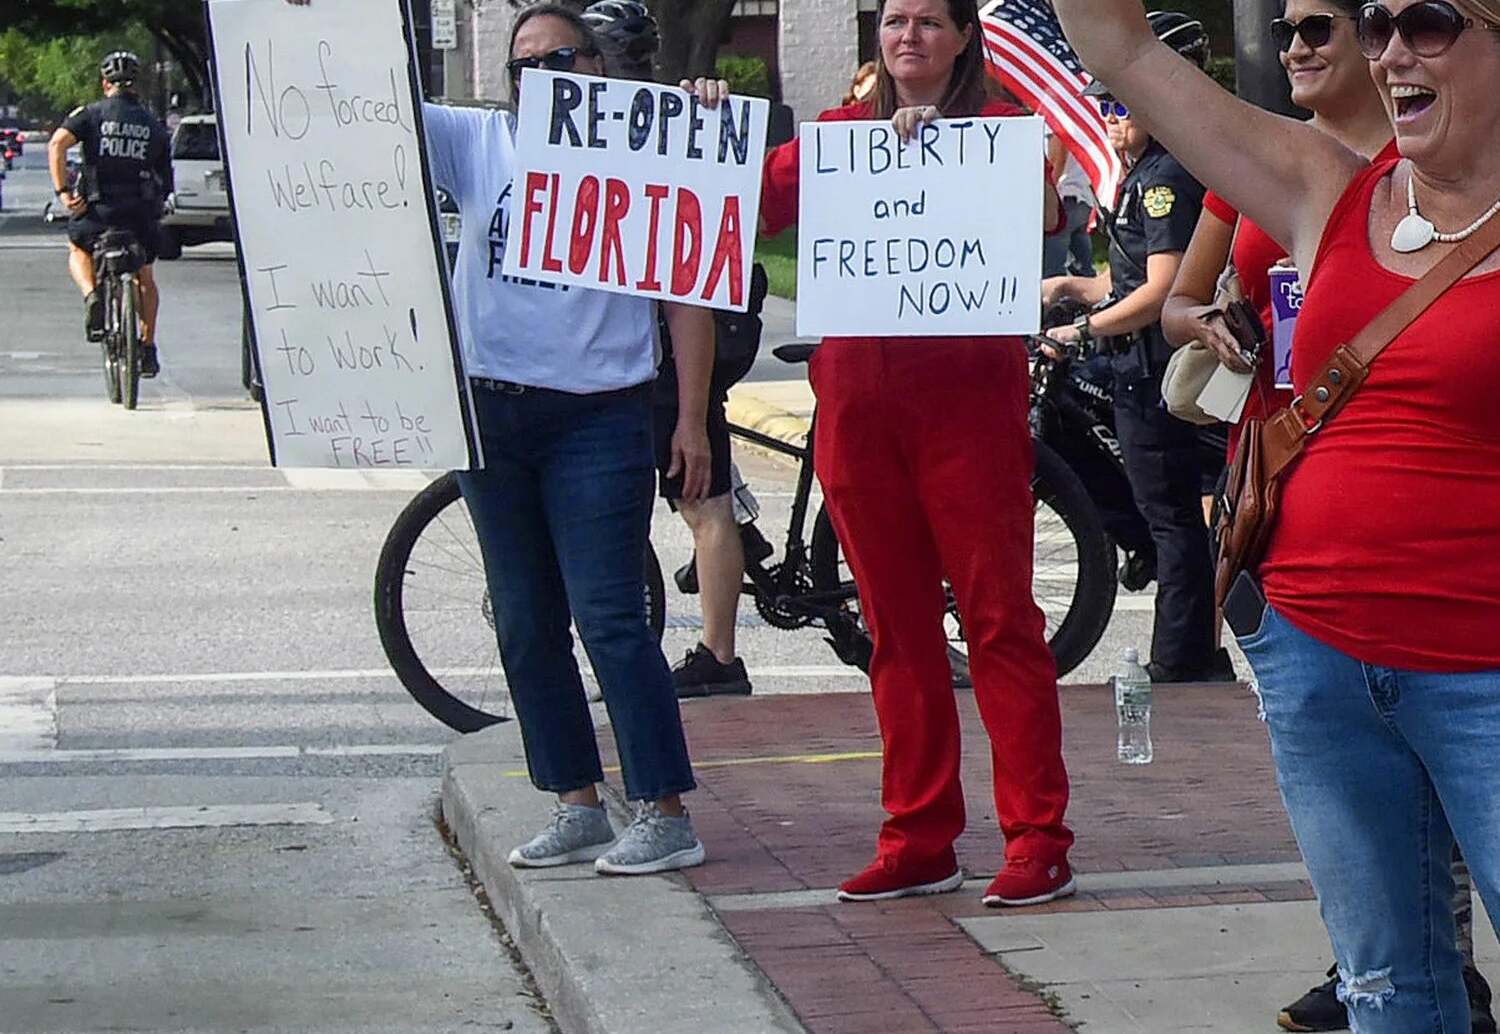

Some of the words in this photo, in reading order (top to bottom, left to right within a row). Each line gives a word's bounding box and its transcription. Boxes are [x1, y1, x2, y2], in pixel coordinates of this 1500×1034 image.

[246, 39, 310, 140] No
[316, 40, 412, 133] forced
[100, 120, 150, 139] ORLANDO
[548, 78, 751, 165] RE-OPEN
[99, 137, 150, 160] POLICE
[816, 122, 1001, 174] LIBERTY
[874, 190, 925, 218] and
[519, 171, 743, 306] FLORIDA
[813, 238, 986, 279] FREEDOM
[257, 265, 297, 311] I
[311, 249, 390, 308] want
[277, 328, 314, 376] to
[276, 400, 304, 437] I
[308, 401, 351, 434] want
[361, 400, 388, 434] to
[400, 403, 432, 434] be
[331, 437, 434, 466] FREE!!
